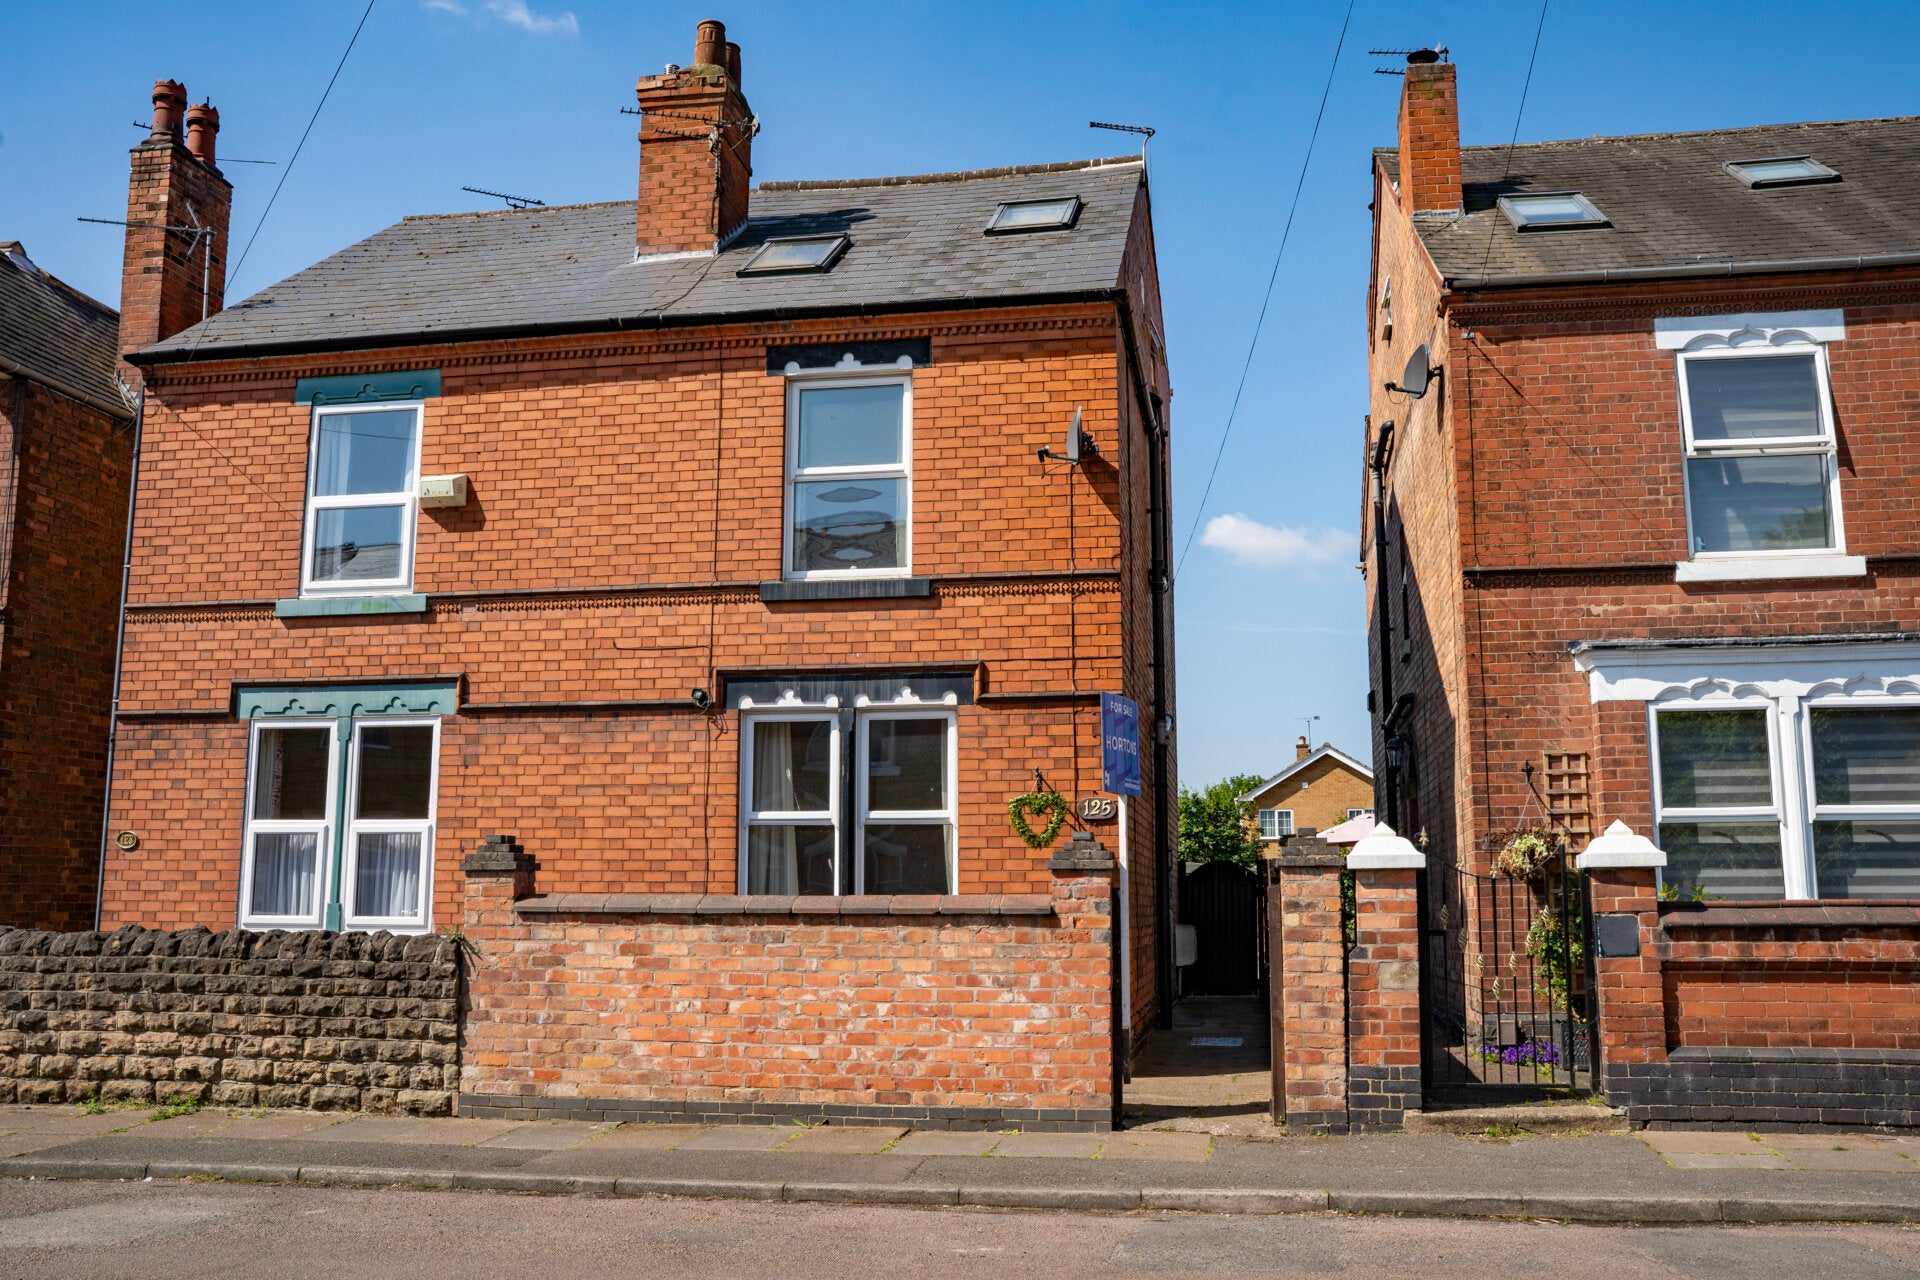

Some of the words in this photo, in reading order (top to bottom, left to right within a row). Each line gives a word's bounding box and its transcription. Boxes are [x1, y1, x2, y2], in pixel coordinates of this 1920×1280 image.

[1110, 701, 1122, 714] FOR
[1123, 704, 1133, 717] SALE
[1106, 734, 1137, 756] HORTONS
[1083, 799, 1111, 816] 125
